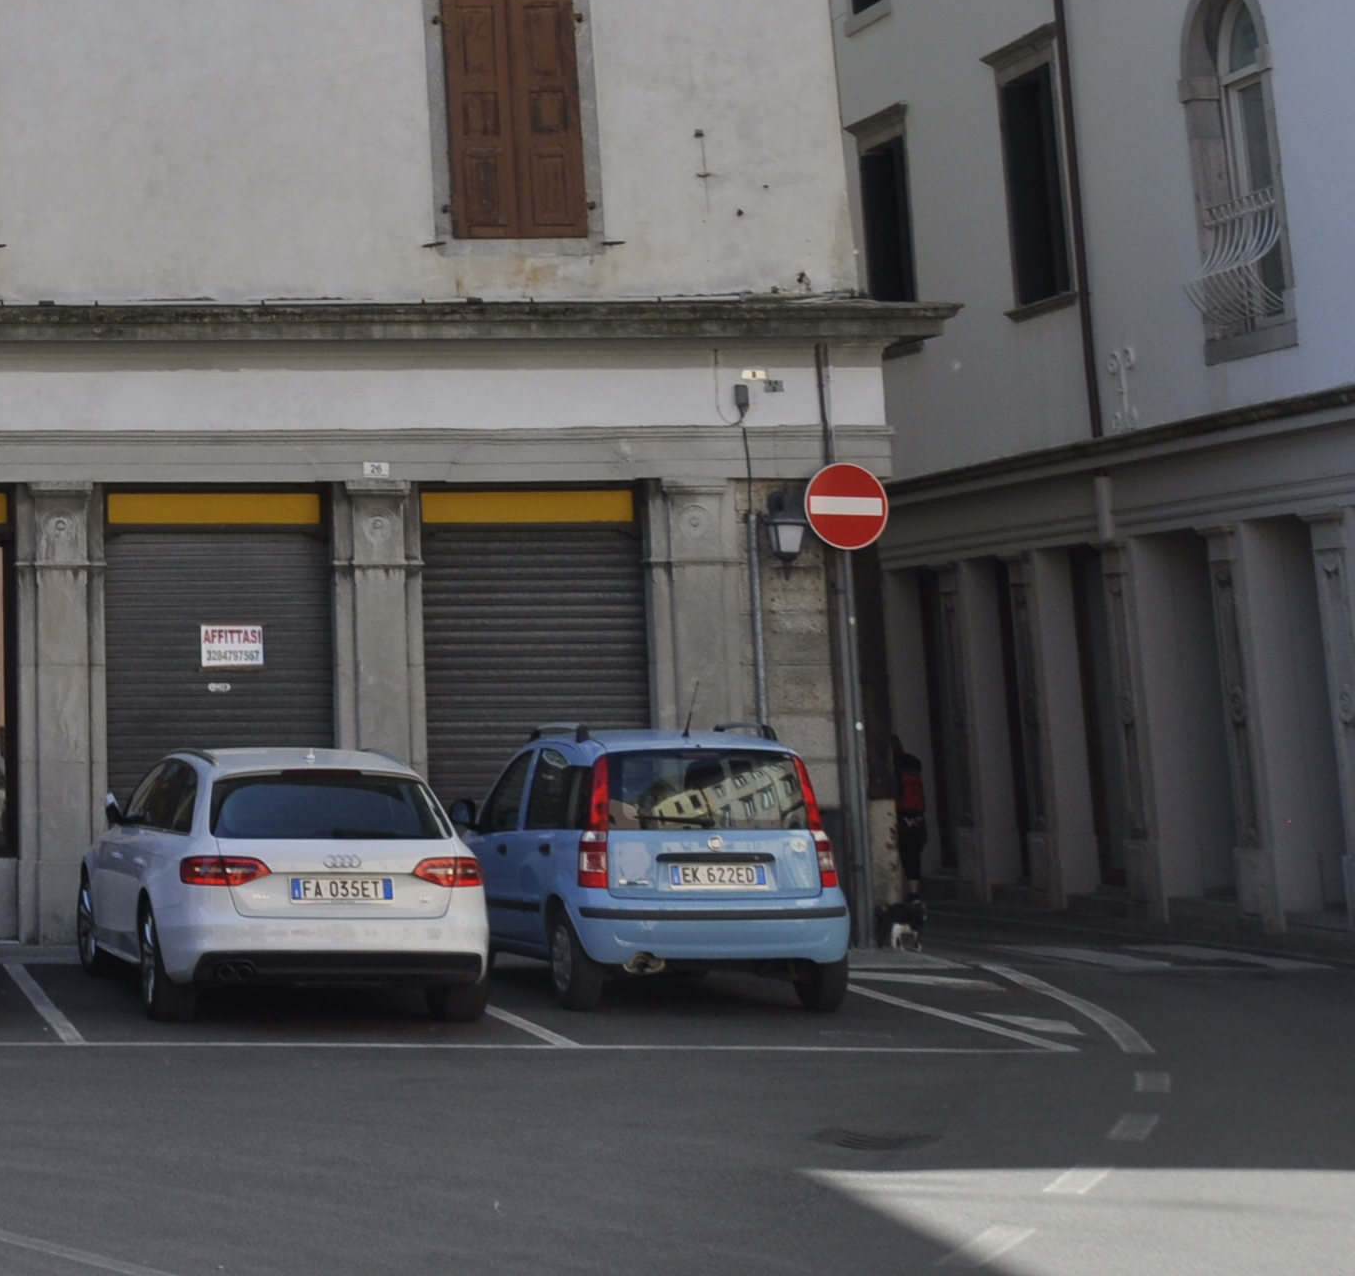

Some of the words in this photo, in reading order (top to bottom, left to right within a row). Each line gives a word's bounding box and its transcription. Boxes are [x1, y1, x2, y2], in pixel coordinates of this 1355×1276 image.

[203, 629, 261, 644] AFFITTASI
[682, 867, 701, 884] EK
[707, 867, 755, 884] 622ED
[303, 880, 323, 897] FA
[329, 880, 380, 898] 035ET
